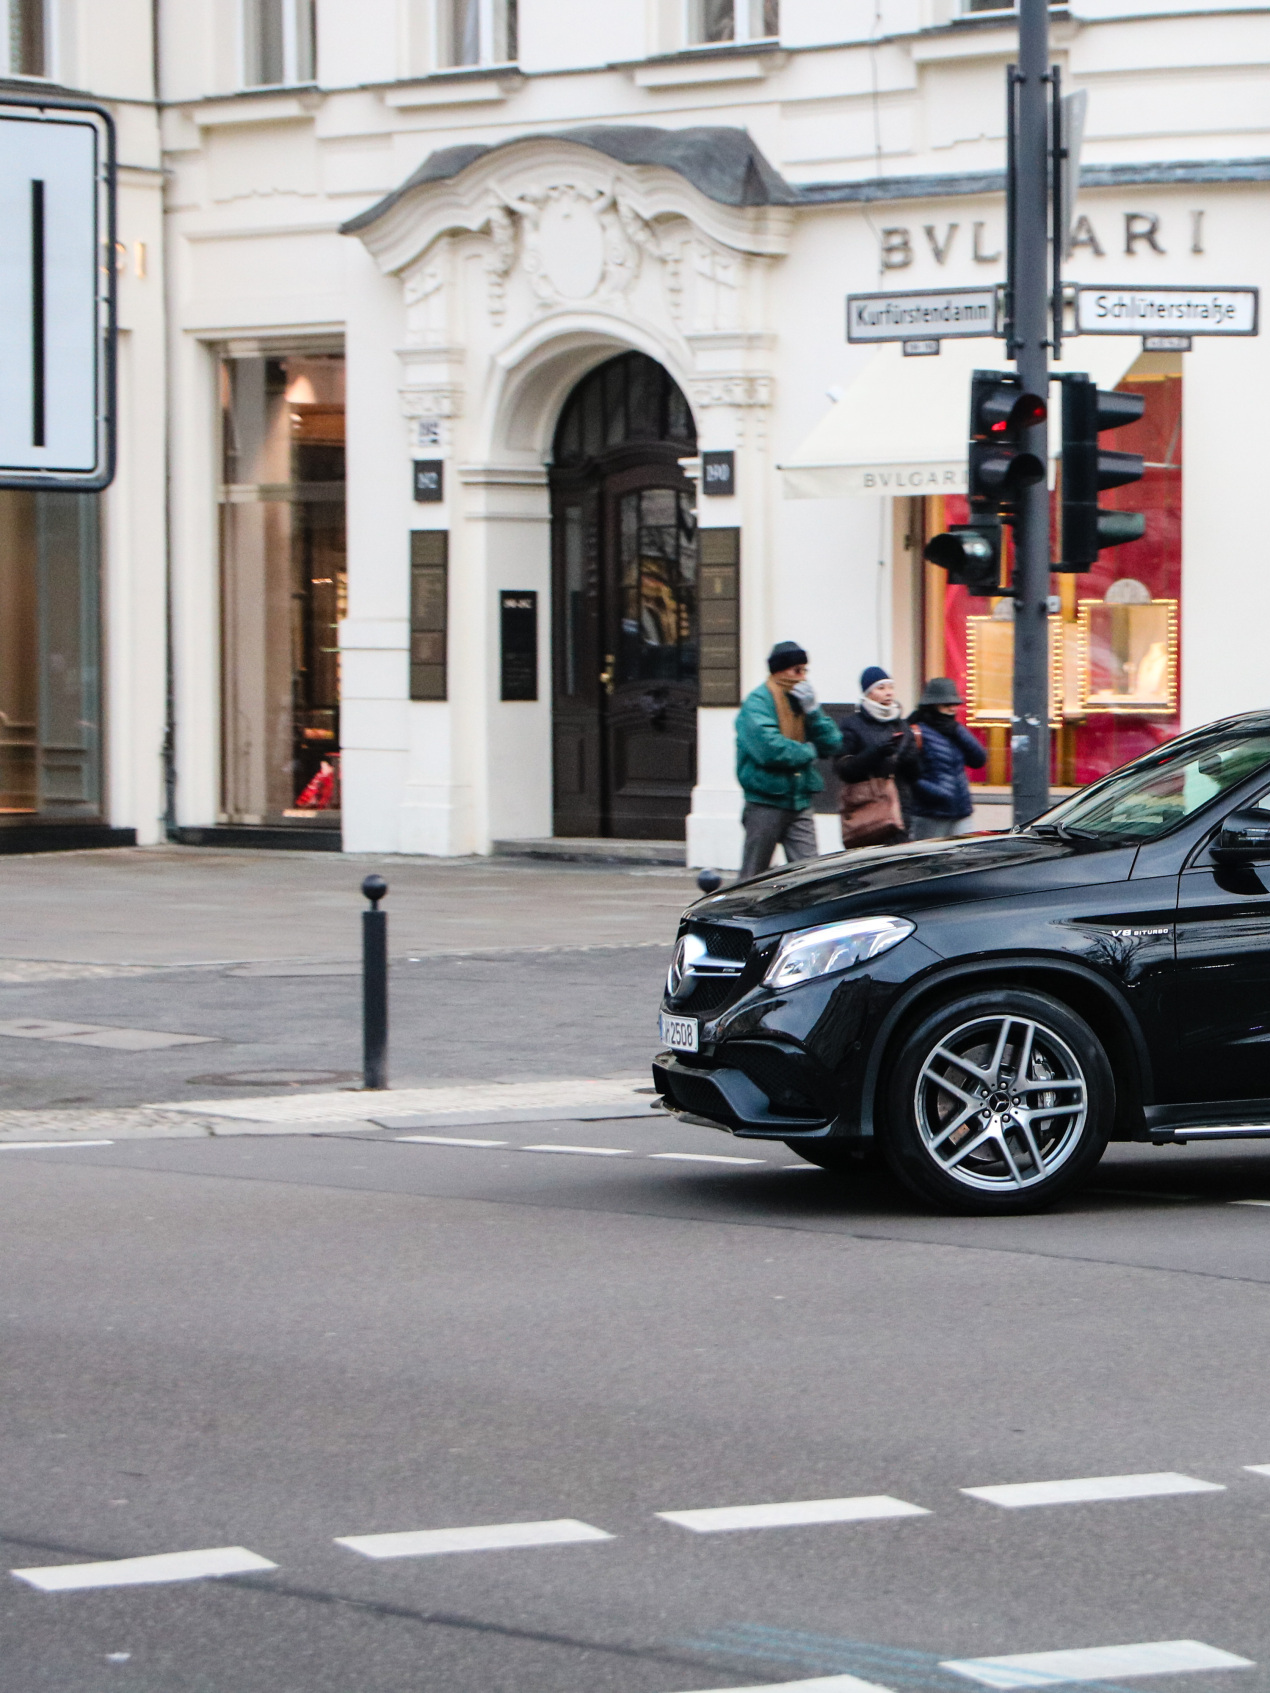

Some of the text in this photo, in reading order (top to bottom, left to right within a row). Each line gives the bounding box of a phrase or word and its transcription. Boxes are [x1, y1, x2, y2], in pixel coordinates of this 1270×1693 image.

[881, 210, 1206, 270] BVLARI
[855, 300, 989, 327] Kurfürstendamm
[1095, 295, 1237, 324] Schlüterstraße
[1111, 928, 1169, 937] V8 BITURBO
